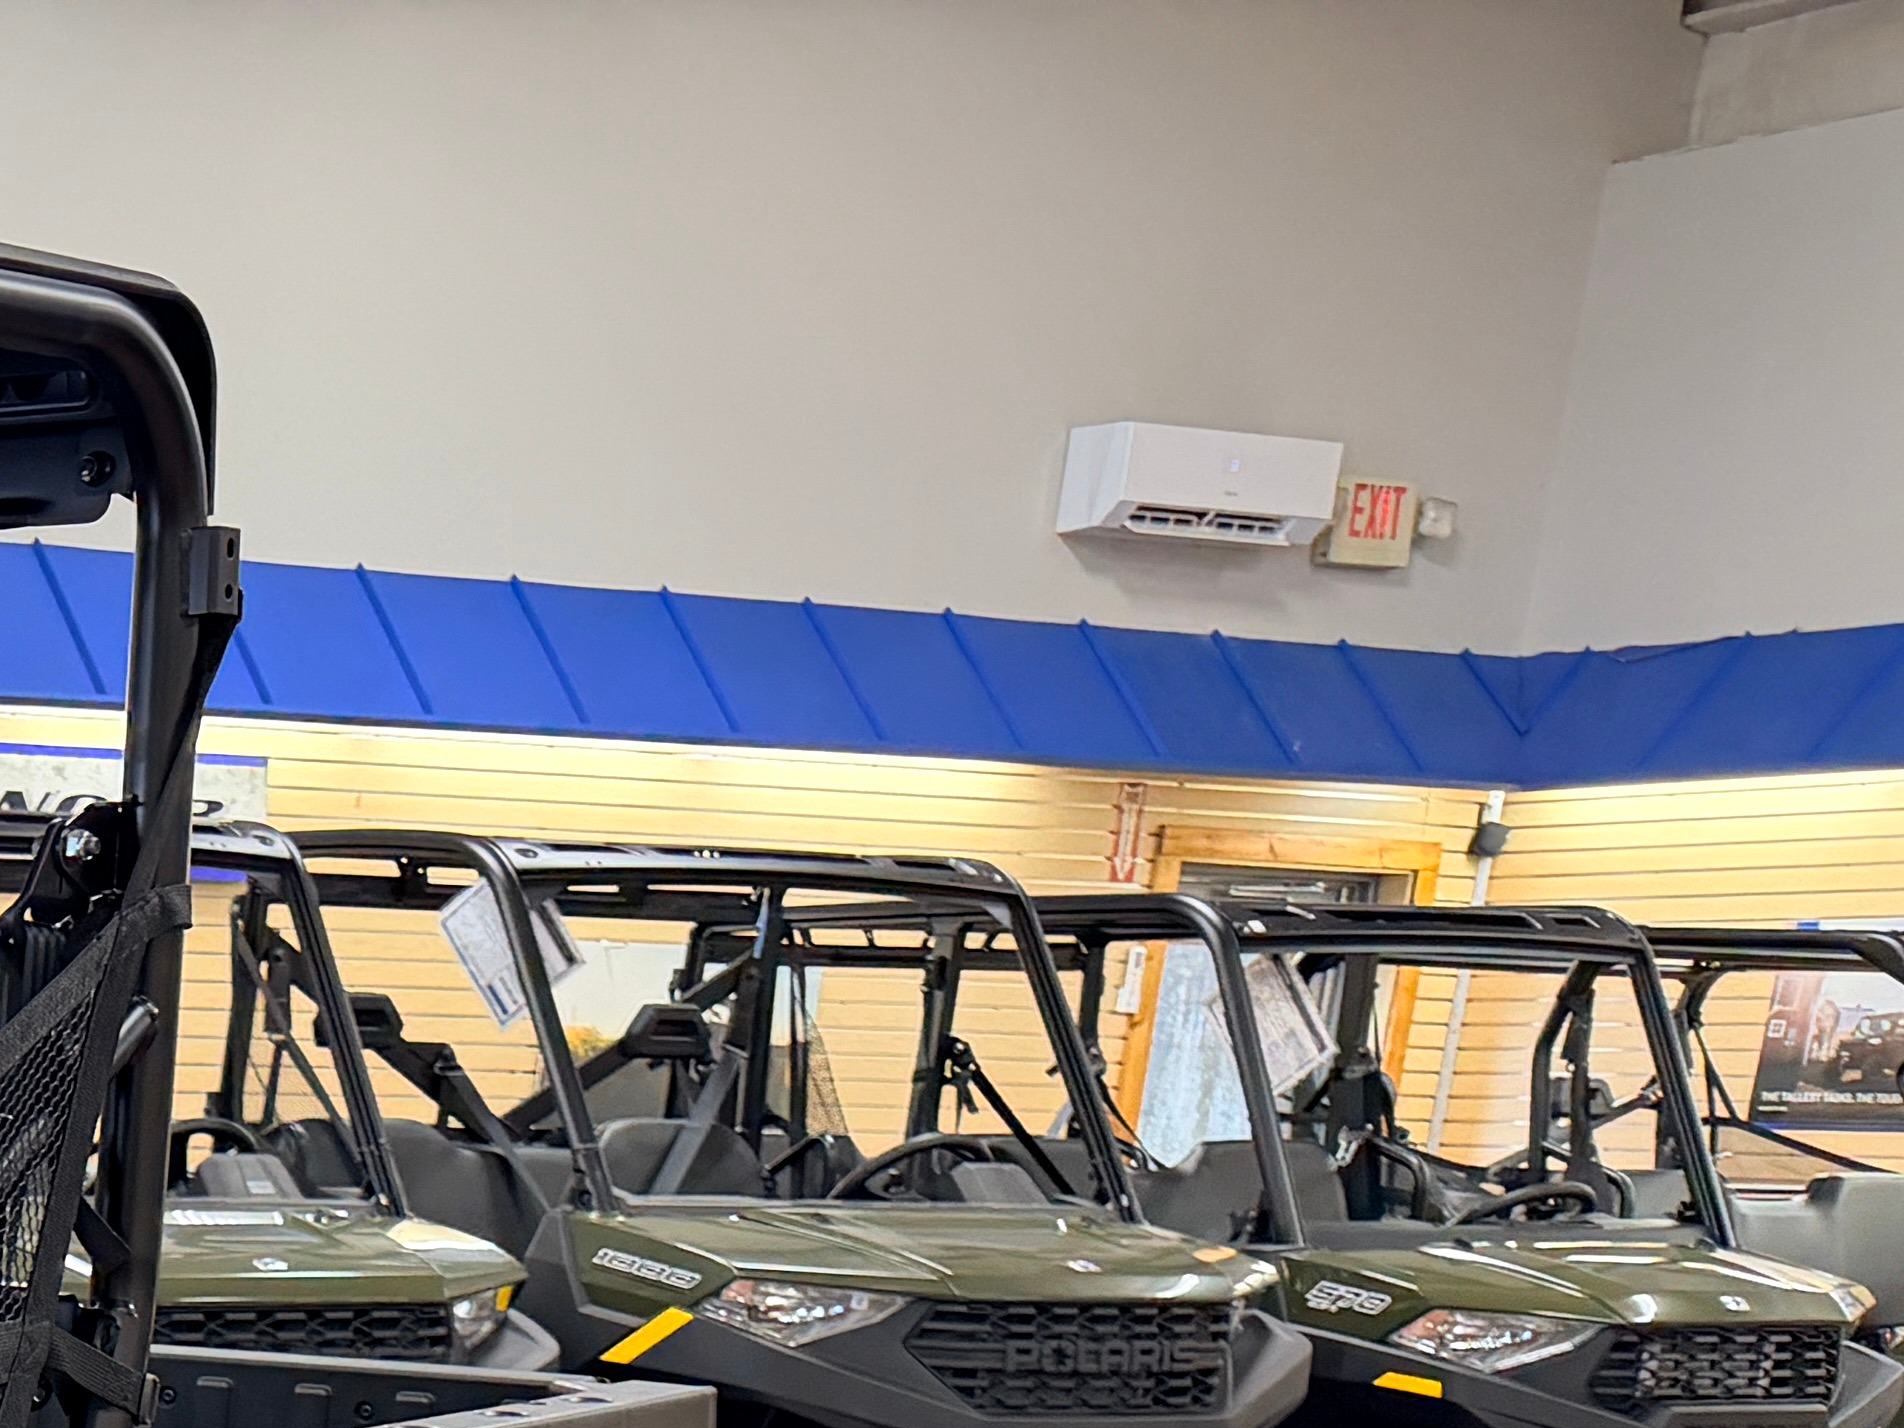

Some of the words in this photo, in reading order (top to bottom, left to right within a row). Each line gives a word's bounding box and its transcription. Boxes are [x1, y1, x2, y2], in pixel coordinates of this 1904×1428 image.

[1349, 483, 1407, 540] EXIT
[592, 1247, 703, 1290] 1000
[1005, 1339, 1225, 1373] POLARIS
